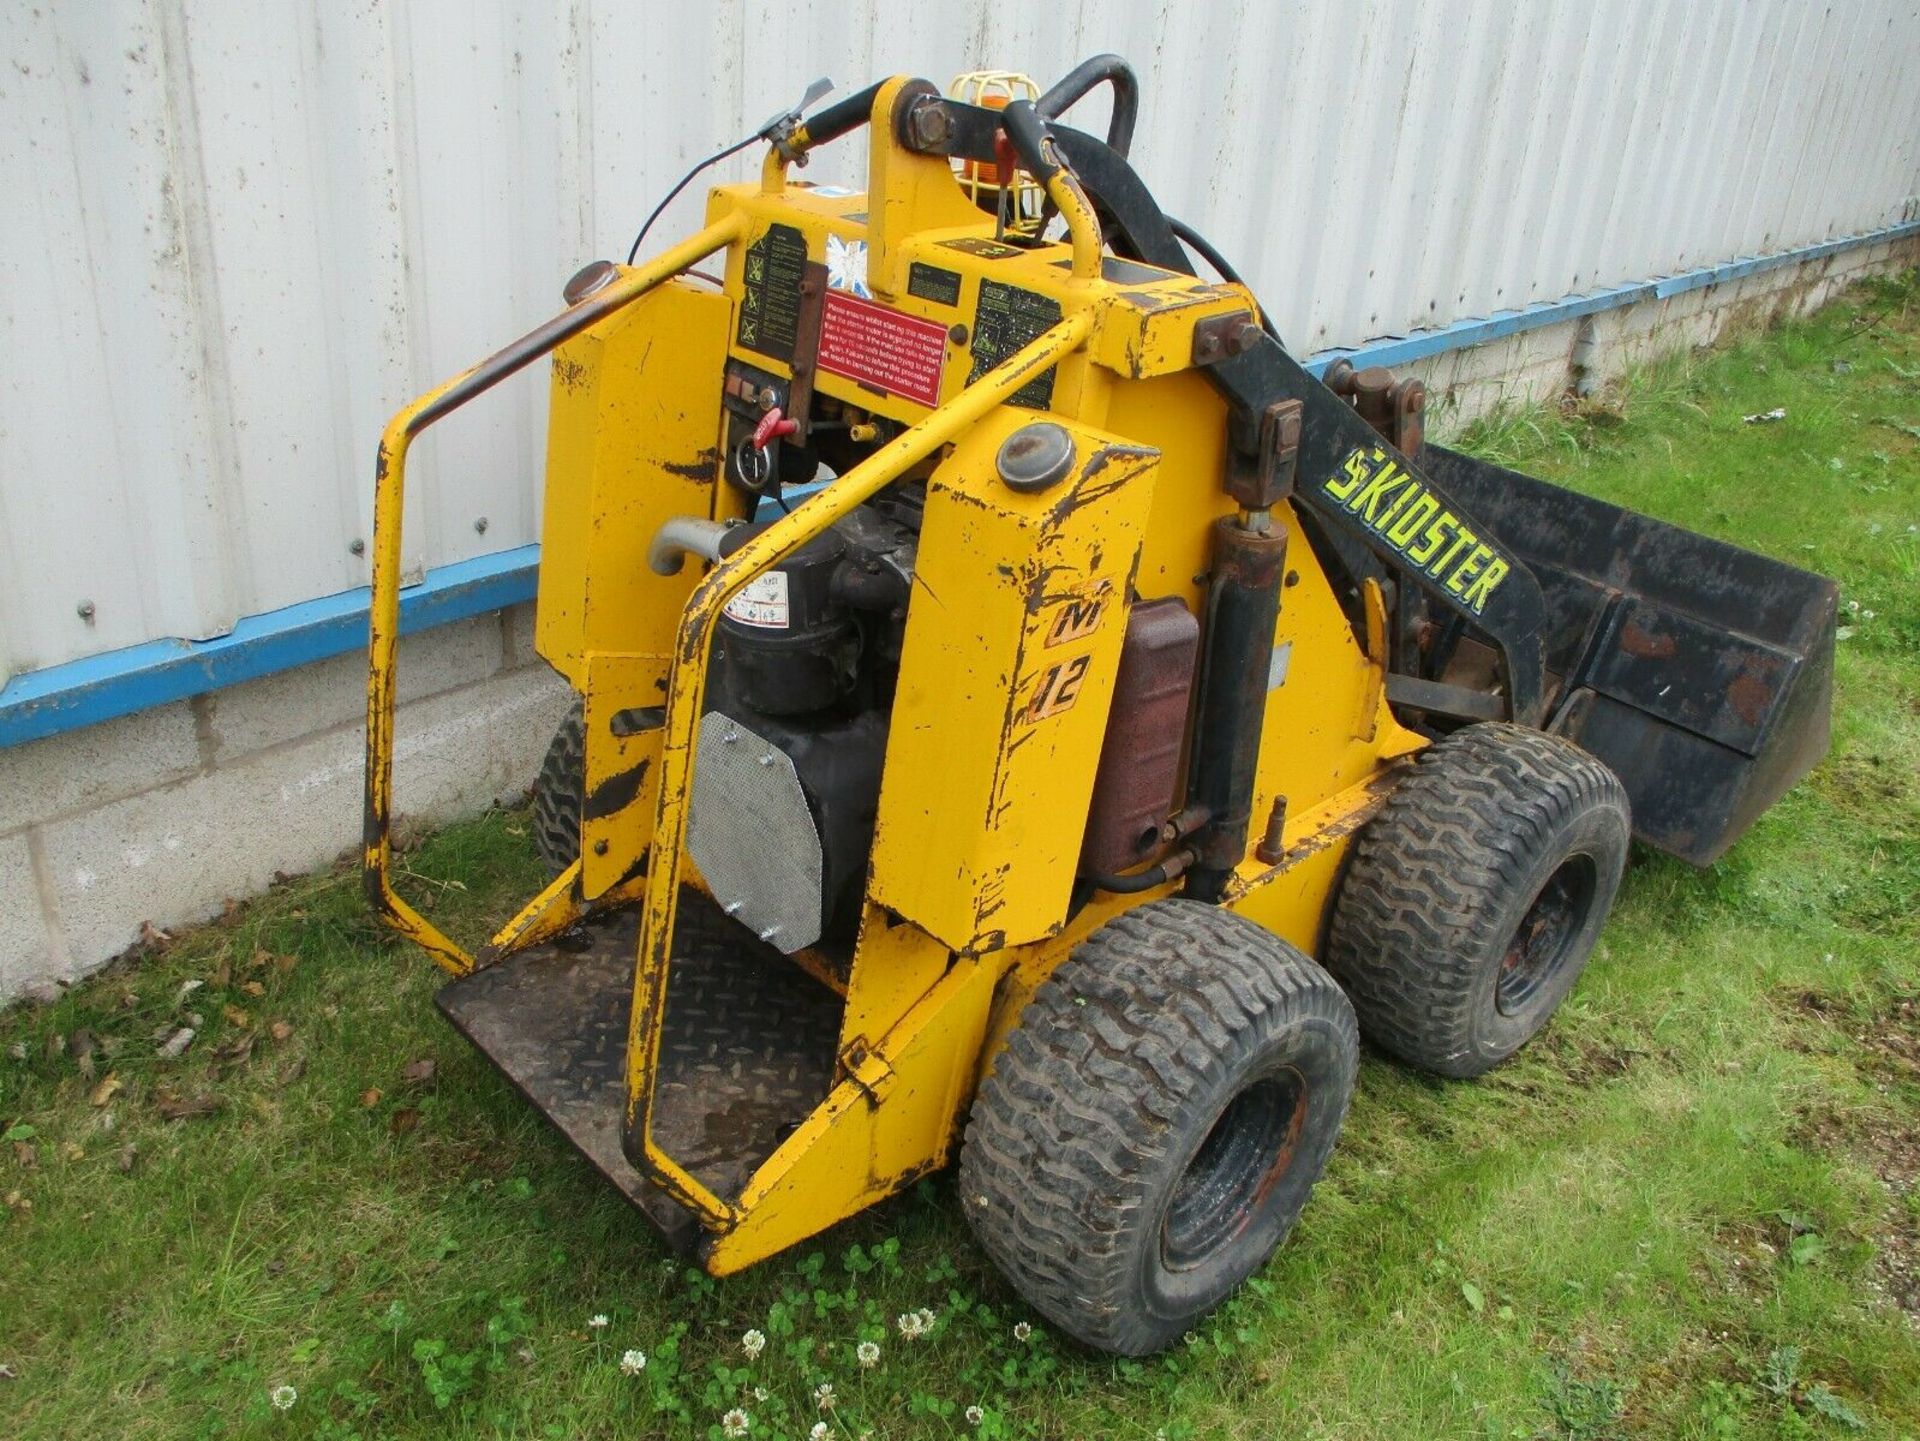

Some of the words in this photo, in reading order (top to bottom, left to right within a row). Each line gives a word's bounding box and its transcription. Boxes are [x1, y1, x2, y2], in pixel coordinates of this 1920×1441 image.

[827, 303, 845, 313] Please
[917, 333, 941, 345] machine
[879, 350, 897, 360] before
[922, 344, 941, 356] longer
[1324, 448, 1510, 613] SKIDSTER
[1035, 655, 1092, 714] 12
